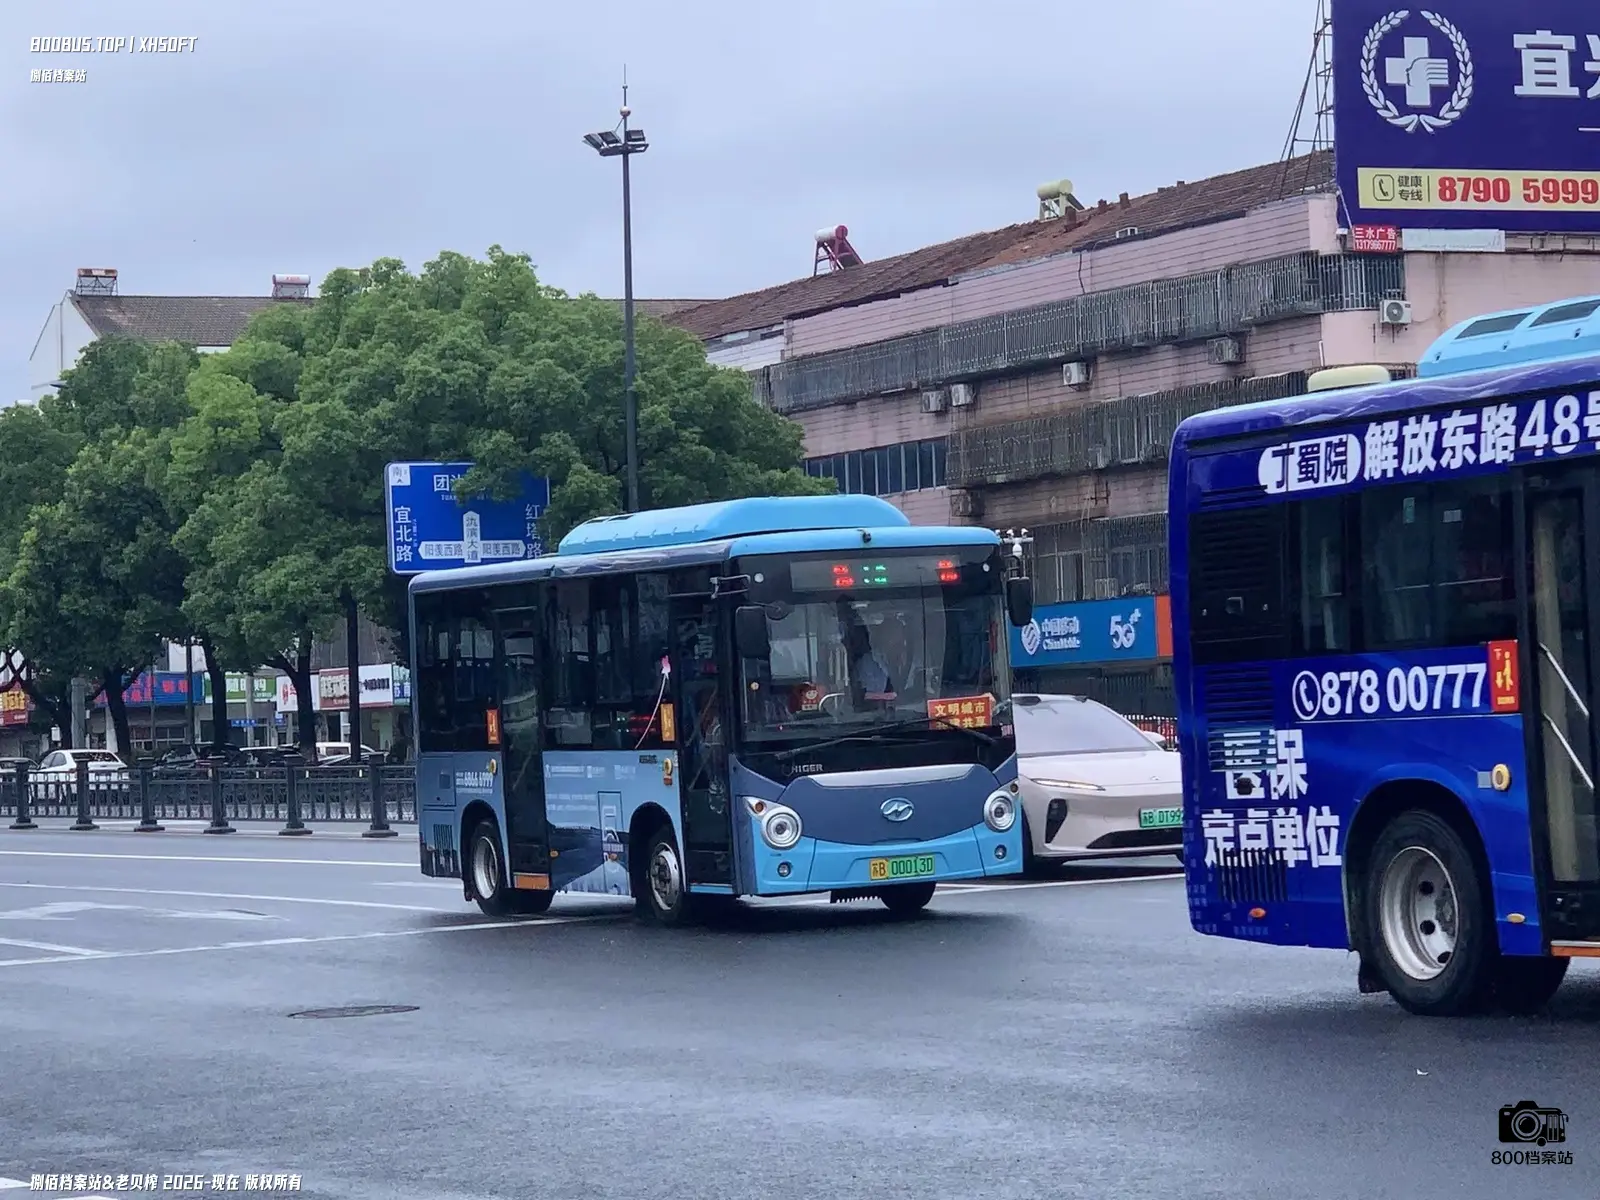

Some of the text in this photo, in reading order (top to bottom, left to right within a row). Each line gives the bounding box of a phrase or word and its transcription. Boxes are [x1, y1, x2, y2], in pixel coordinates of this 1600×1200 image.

[1398, 175, 1422, 187] 健康
[1438, 176, 1599, 204] 8790 5999
[1398, 189, 1423, 201] 专线
[1355, 227, 1396, 240] 三水广告
[1269, 437, 1349, 489] 丁蜀院
[394, 505, 413, 563] 宜北路
[525, 503, 543, 559] 红塔路
[1042, 616, 1080, 636] 中国移动
[1321, 663, 1487, 716] 878 00777
[934, 702, 986, 717] 文明城市
[791, 764, 823, 773] HIGER
[1201, 806, 1342, 868] 定点单位
